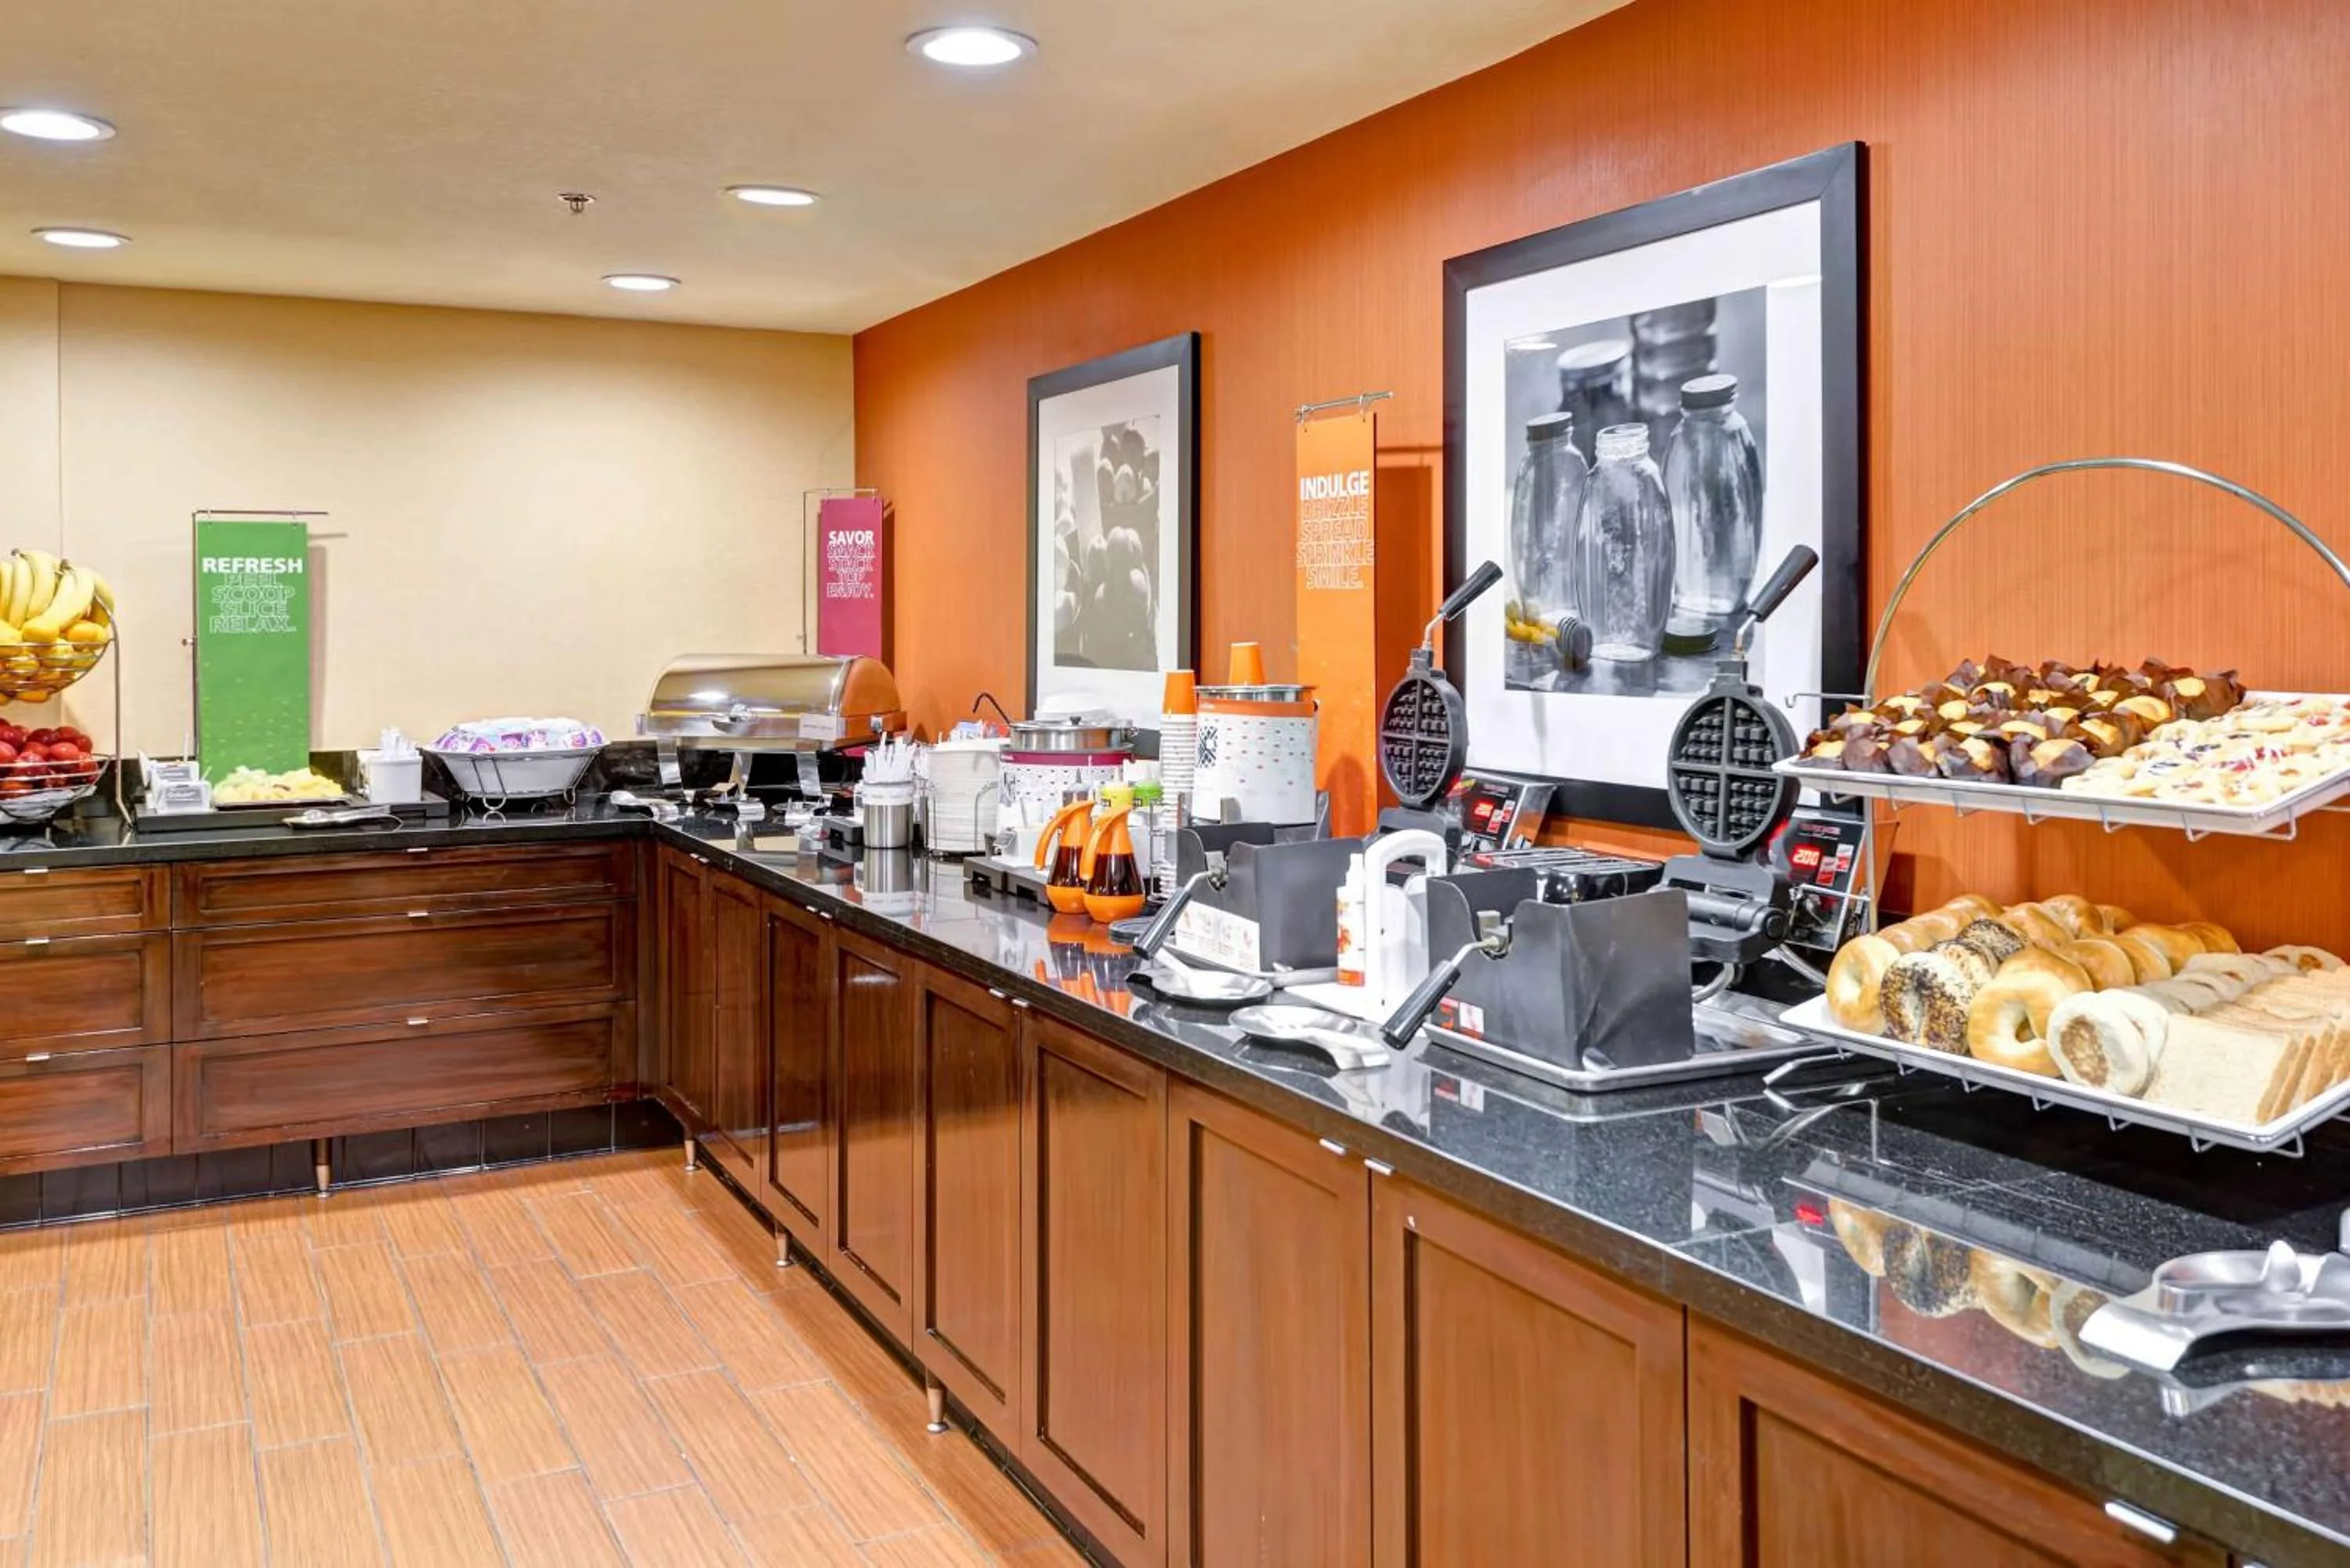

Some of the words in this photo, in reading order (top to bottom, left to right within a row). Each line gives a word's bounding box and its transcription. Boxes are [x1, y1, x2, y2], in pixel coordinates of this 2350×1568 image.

[1300, 470, 1370, 500] INDULGE
[828, 530, 874, 546] SAVOR
[202, 557, 303, 573] REFRESH
[211, 586, 296, 604] SCOOP
[219, 602, 287, 617] SLICE
[1792, 847, 1820, 866] 200
